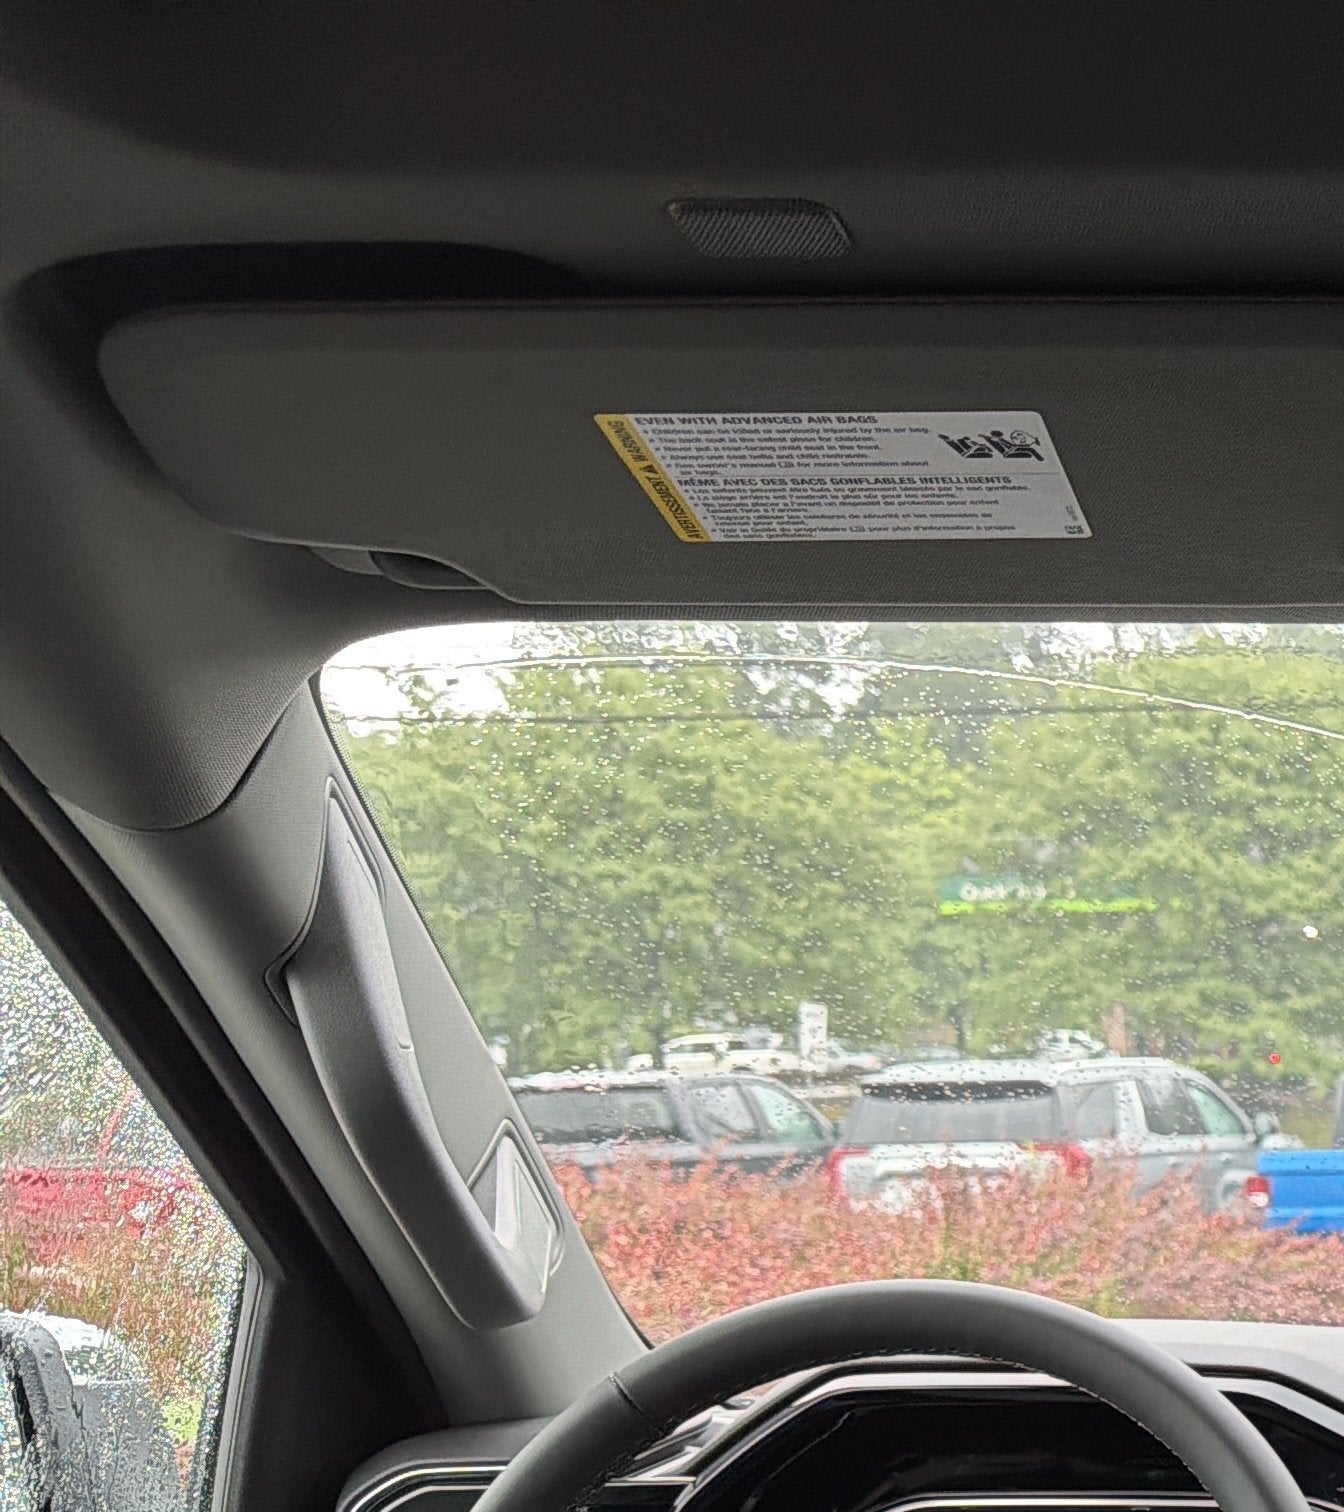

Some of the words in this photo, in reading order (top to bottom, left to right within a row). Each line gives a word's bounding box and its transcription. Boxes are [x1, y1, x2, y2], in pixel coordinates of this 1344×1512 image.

[632, 416, 677, 425] EVEN
[674, 416, 720, 425] WITH
[717, 415, 805, 424] ADVANCED
[803, 415, 834, 424] AIR
[832, 415, 879, 423] BAGS
[674, 476, 722, 486] MÊME
[719, 478, 759, 486] AVEC
[757, 477, 789, 486] DES
[787, 477, 829, 485] SACS
[826, 476, 918, 485] GONFLABLES
[916, 475, 1013, 484] INTELLIGENTS
